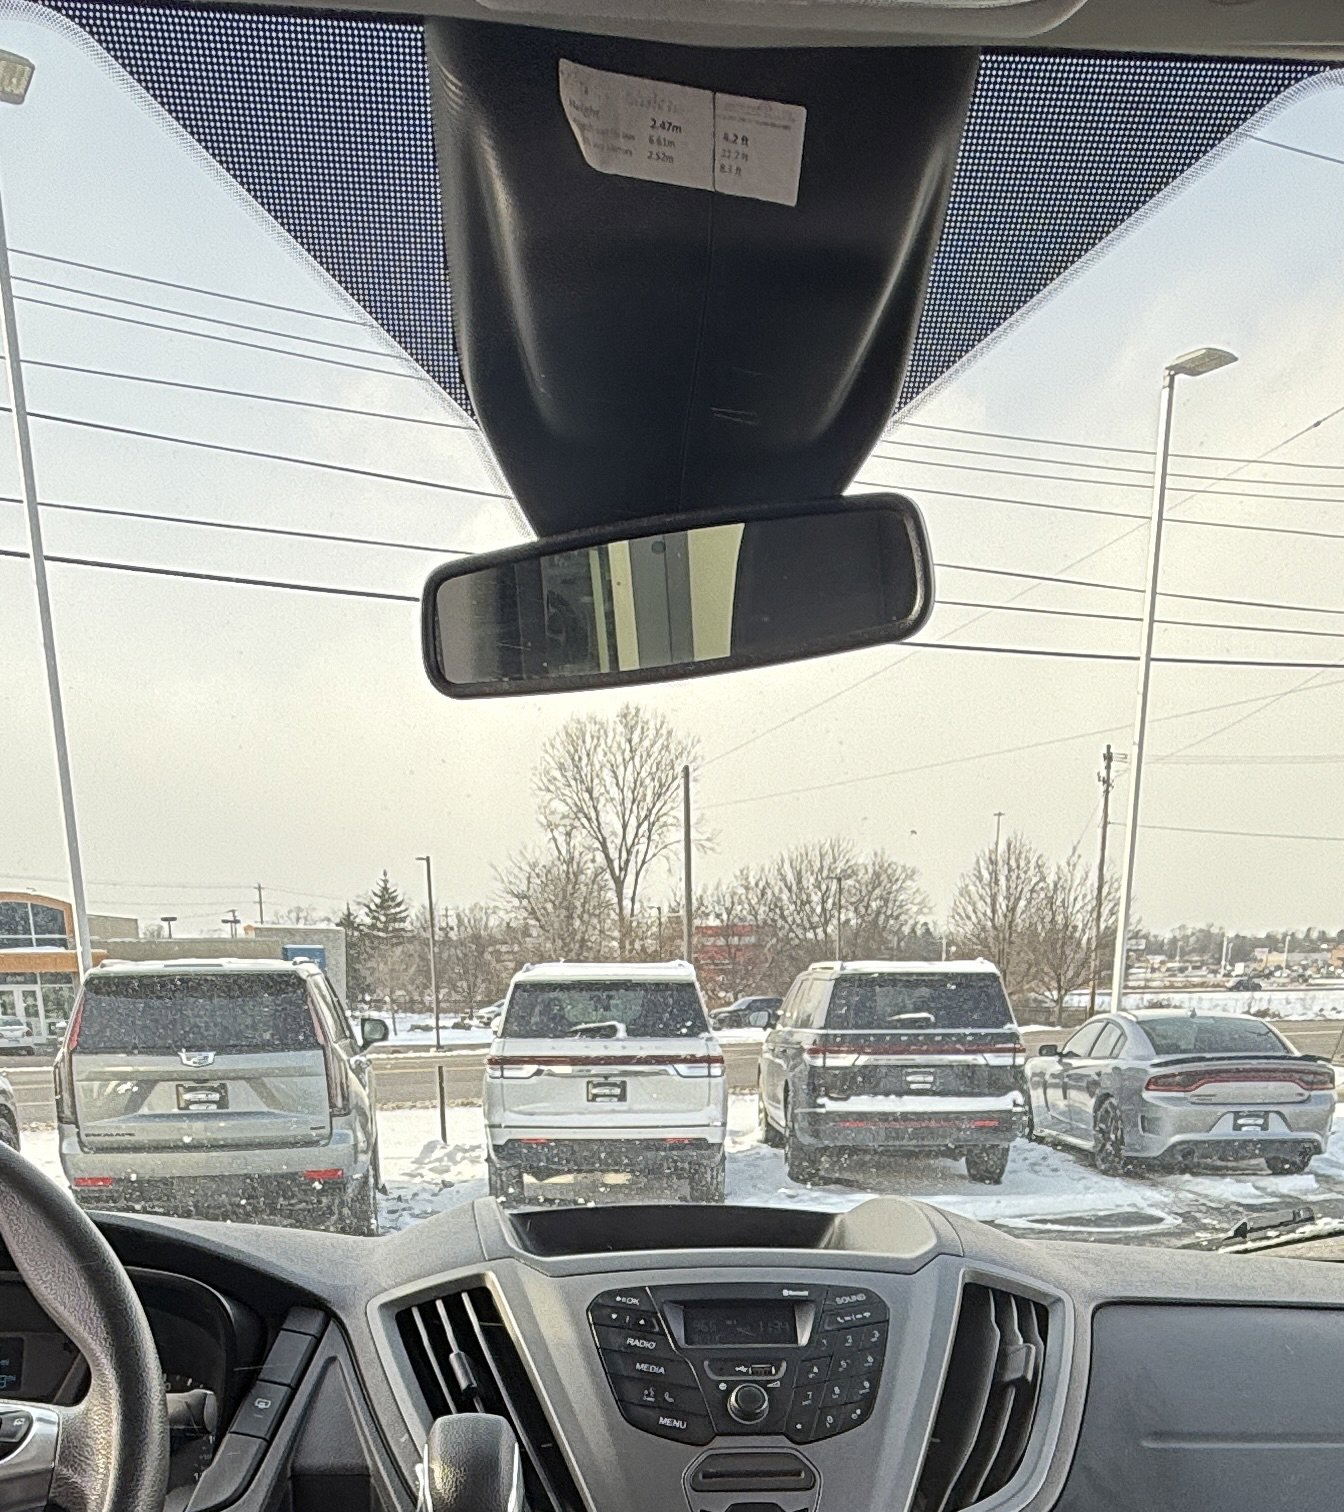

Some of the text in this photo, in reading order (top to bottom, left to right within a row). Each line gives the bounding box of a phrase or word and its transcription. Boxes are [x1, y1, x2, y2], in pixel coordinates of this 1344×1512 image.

[649, 117, 683, 135] 2.47m
[835, 1293, 867, 1304] SOUND
[626, 1337, 656, 1350] RADIO
[635, 1362, 666, 1375] MEDIA
[658, 1415, 687, 1430] MENU
